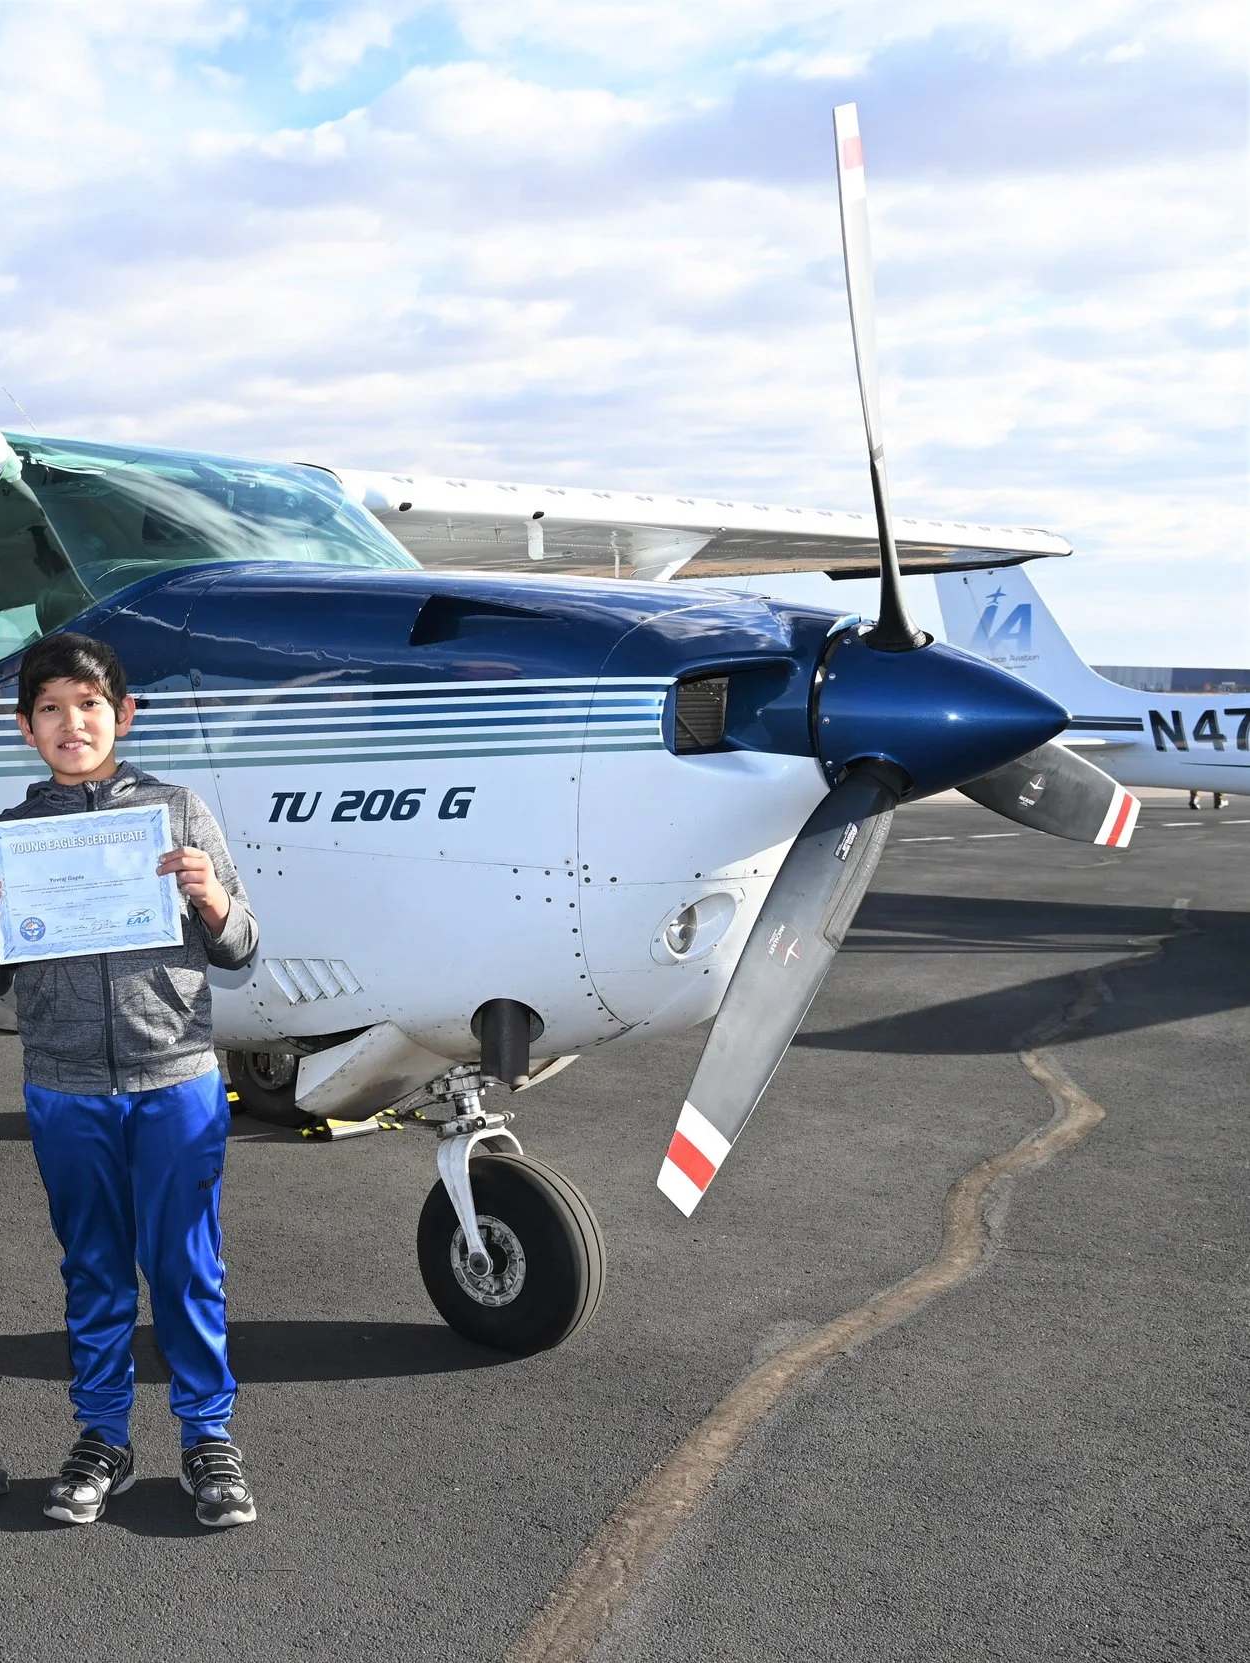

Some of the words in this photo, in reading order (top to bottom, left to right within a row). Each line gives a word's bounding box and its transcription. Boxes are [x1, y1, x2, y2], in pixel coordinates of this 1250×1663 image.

[268, 791, 323, 823] TU
[330, 787, 427, 822] 206
[437, 786, 477, 820] G
[10, 840, 46, 854] YOUNG
[48, 836, 86, 851] EAGLES
[86, 829, 146, 846] CERTIFICATE
[126, 916, 150, 925] EAA
